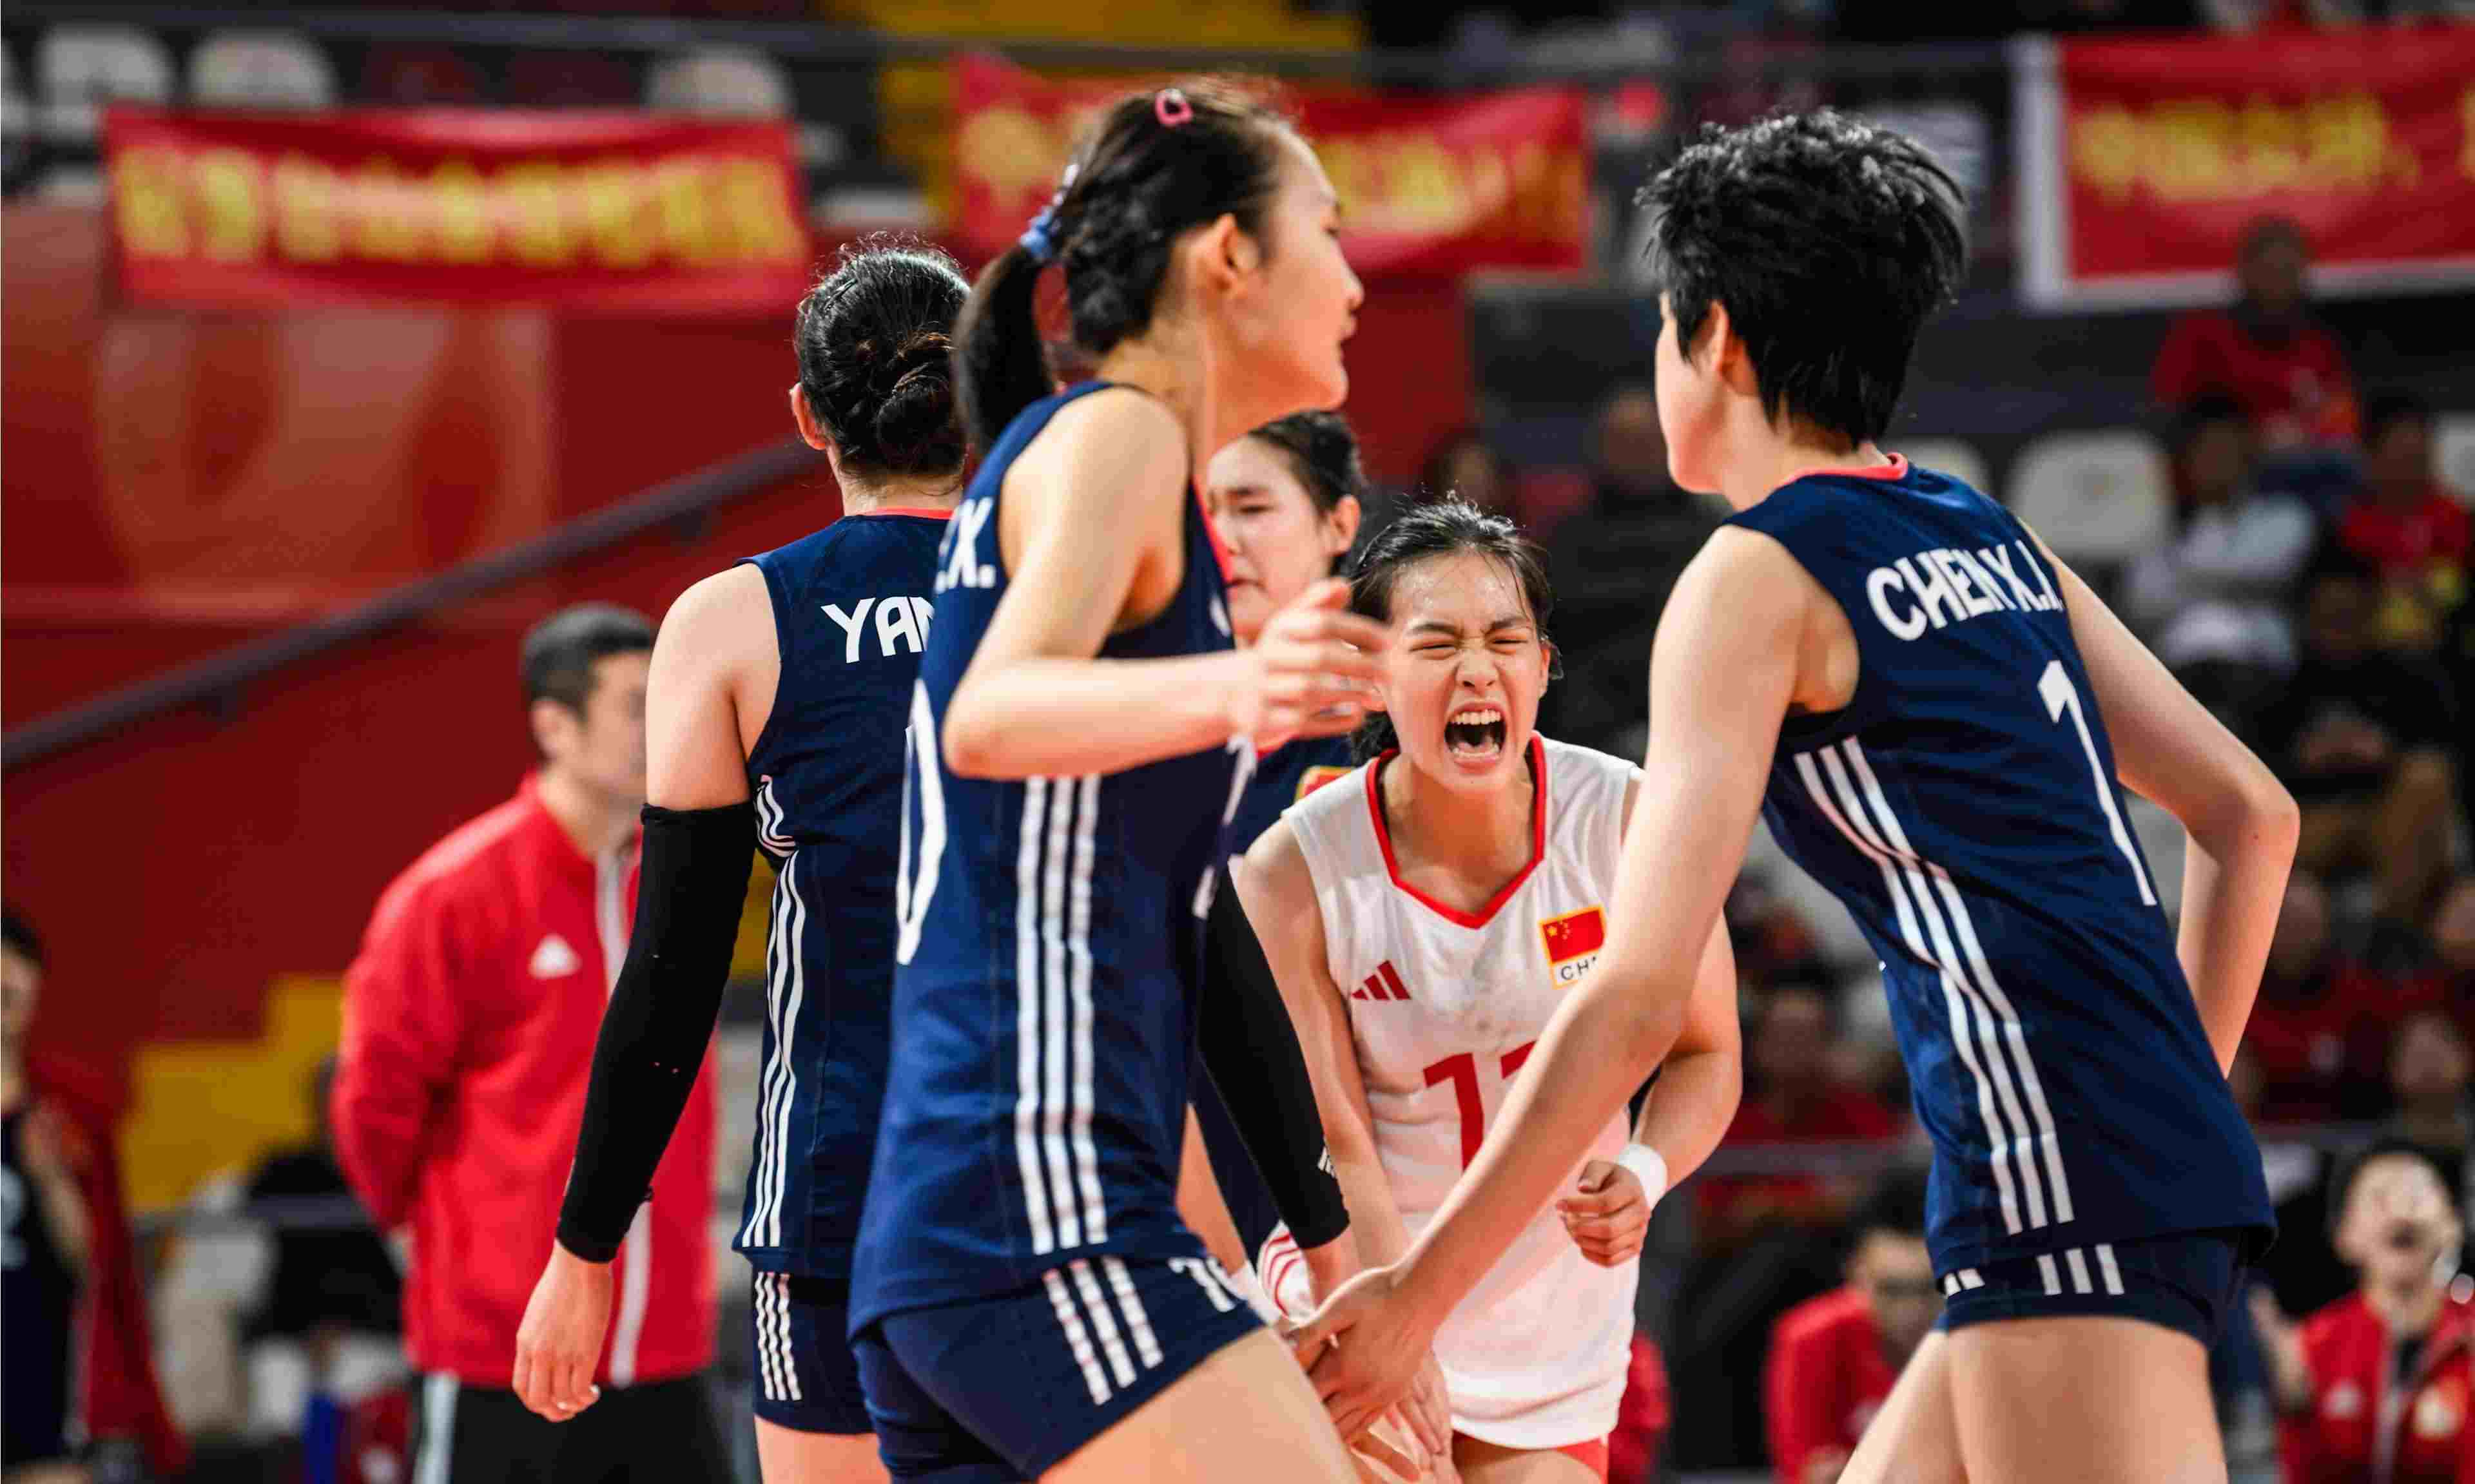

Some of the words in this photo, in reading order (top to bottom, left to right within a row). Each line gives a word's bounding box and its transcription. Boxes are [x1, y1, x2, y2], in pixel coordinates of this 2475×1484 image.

[2037, 659, 2157, 906] 1
[1560, 956, 1597, 980] CH
[1422, 1040, 1538, 1176] 1
